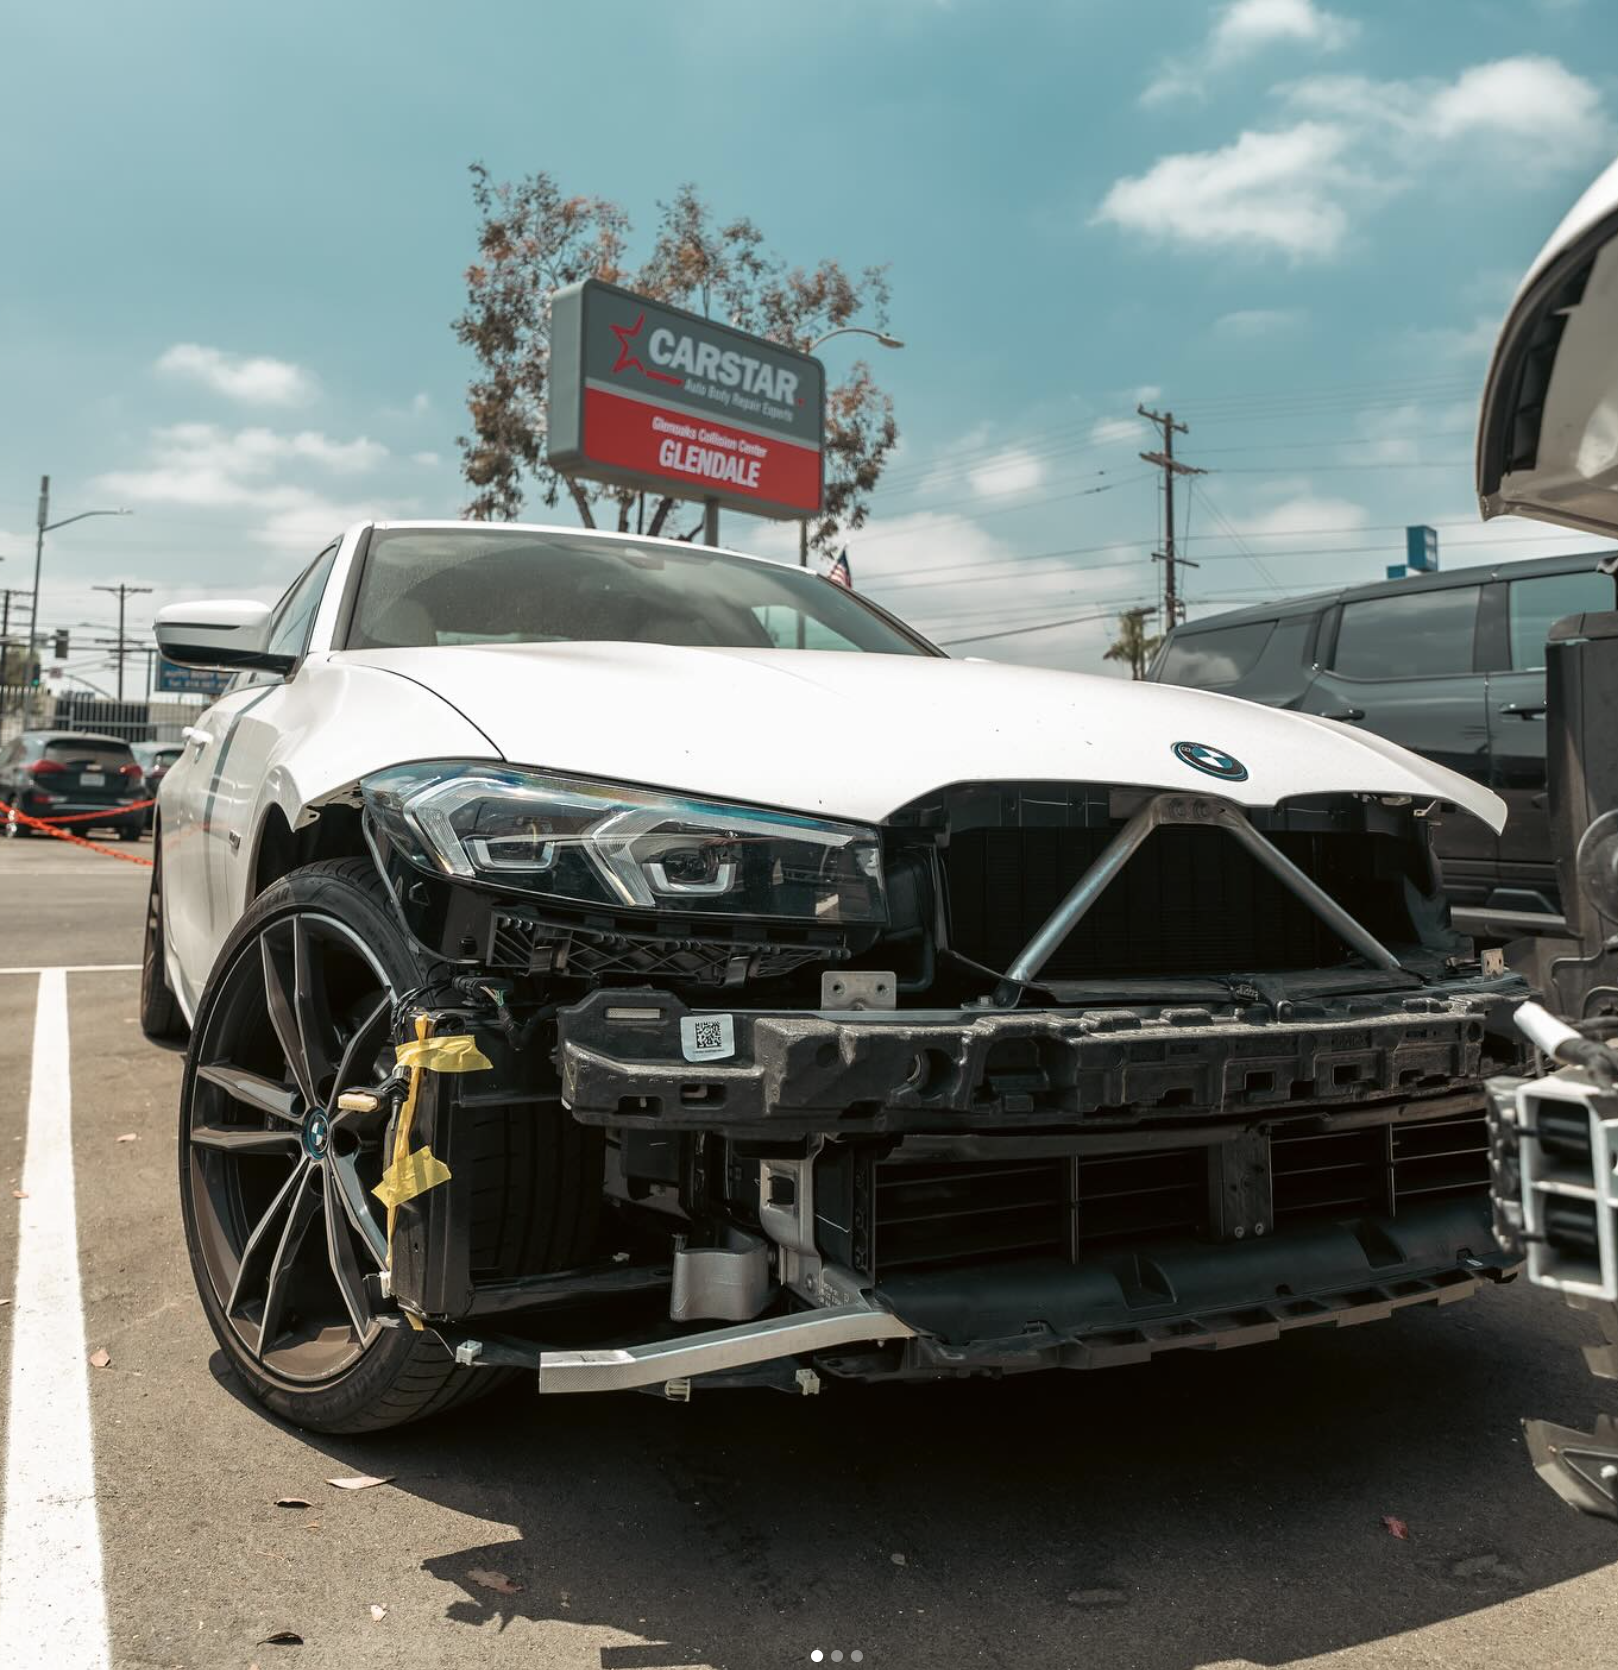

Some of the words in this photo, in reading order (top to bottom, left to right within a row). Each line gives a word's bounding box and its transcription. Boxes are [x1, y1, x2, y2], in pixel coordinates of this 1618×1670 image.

[649, 328, 799, 406] CARSTAR
[684, 379, 706, 396] Auto
[708, 383, 730, 406] Body
[732, 392, 761, 412] Repair
[762, 402, 793, 421] Experts
[652, 416, 697, 439] Glenoaks
[698, 428, 738, 450] Collision
[738, 439, 768, 458] Center
[659, 438, 762, 488] GLENDALE
